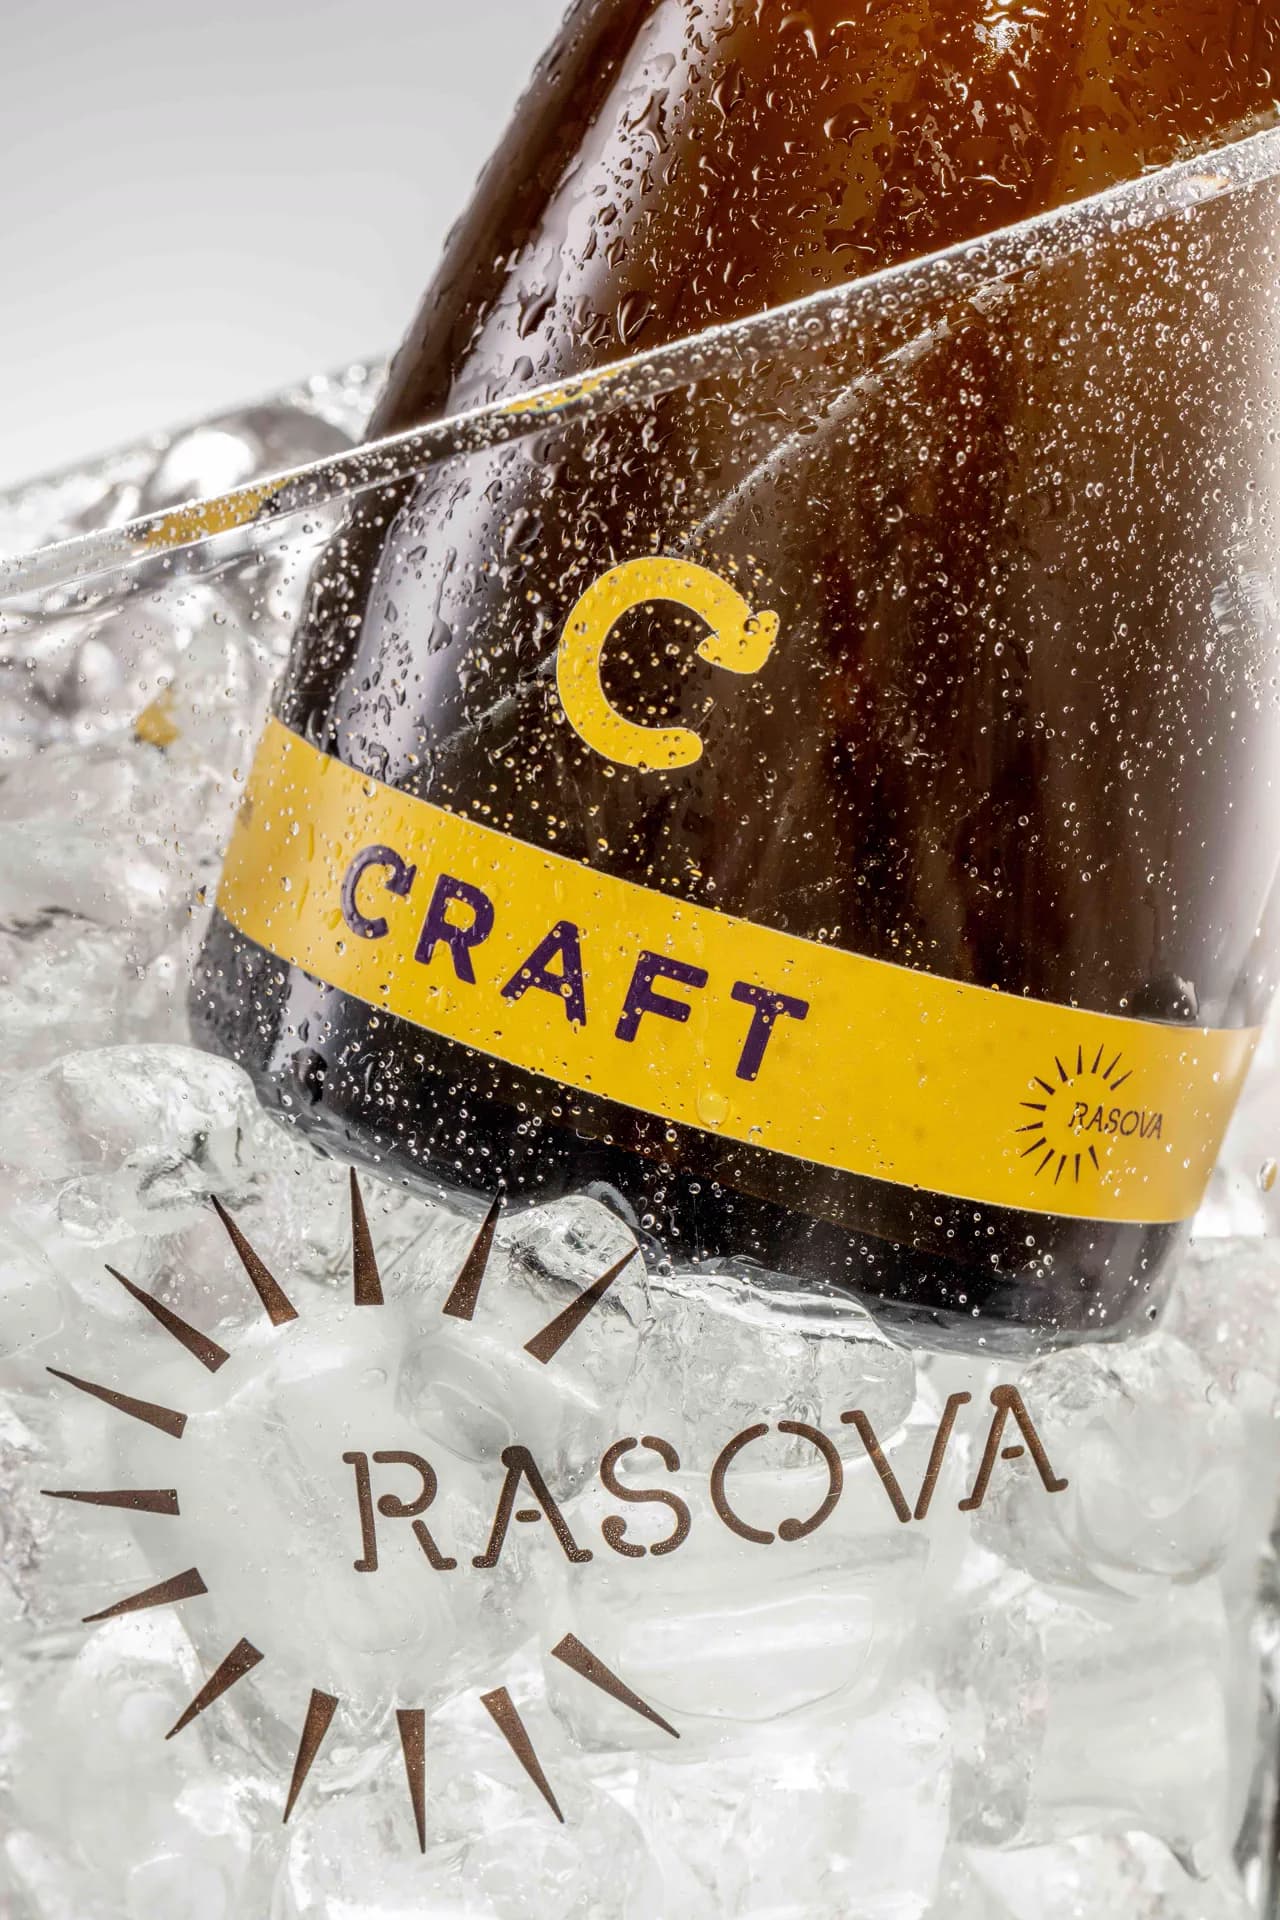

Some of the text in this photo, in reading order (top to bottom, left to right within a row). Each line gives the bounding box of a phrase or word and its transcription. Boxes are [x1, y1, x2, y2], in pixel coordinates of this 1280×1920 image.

[557, 556, 780, 769] C
[341, 844, 810, 1082] CRAFT
[1068, 1101, 1163, 1140] RASOVA
[343, 1384, 1069, 1572] RASOVA
